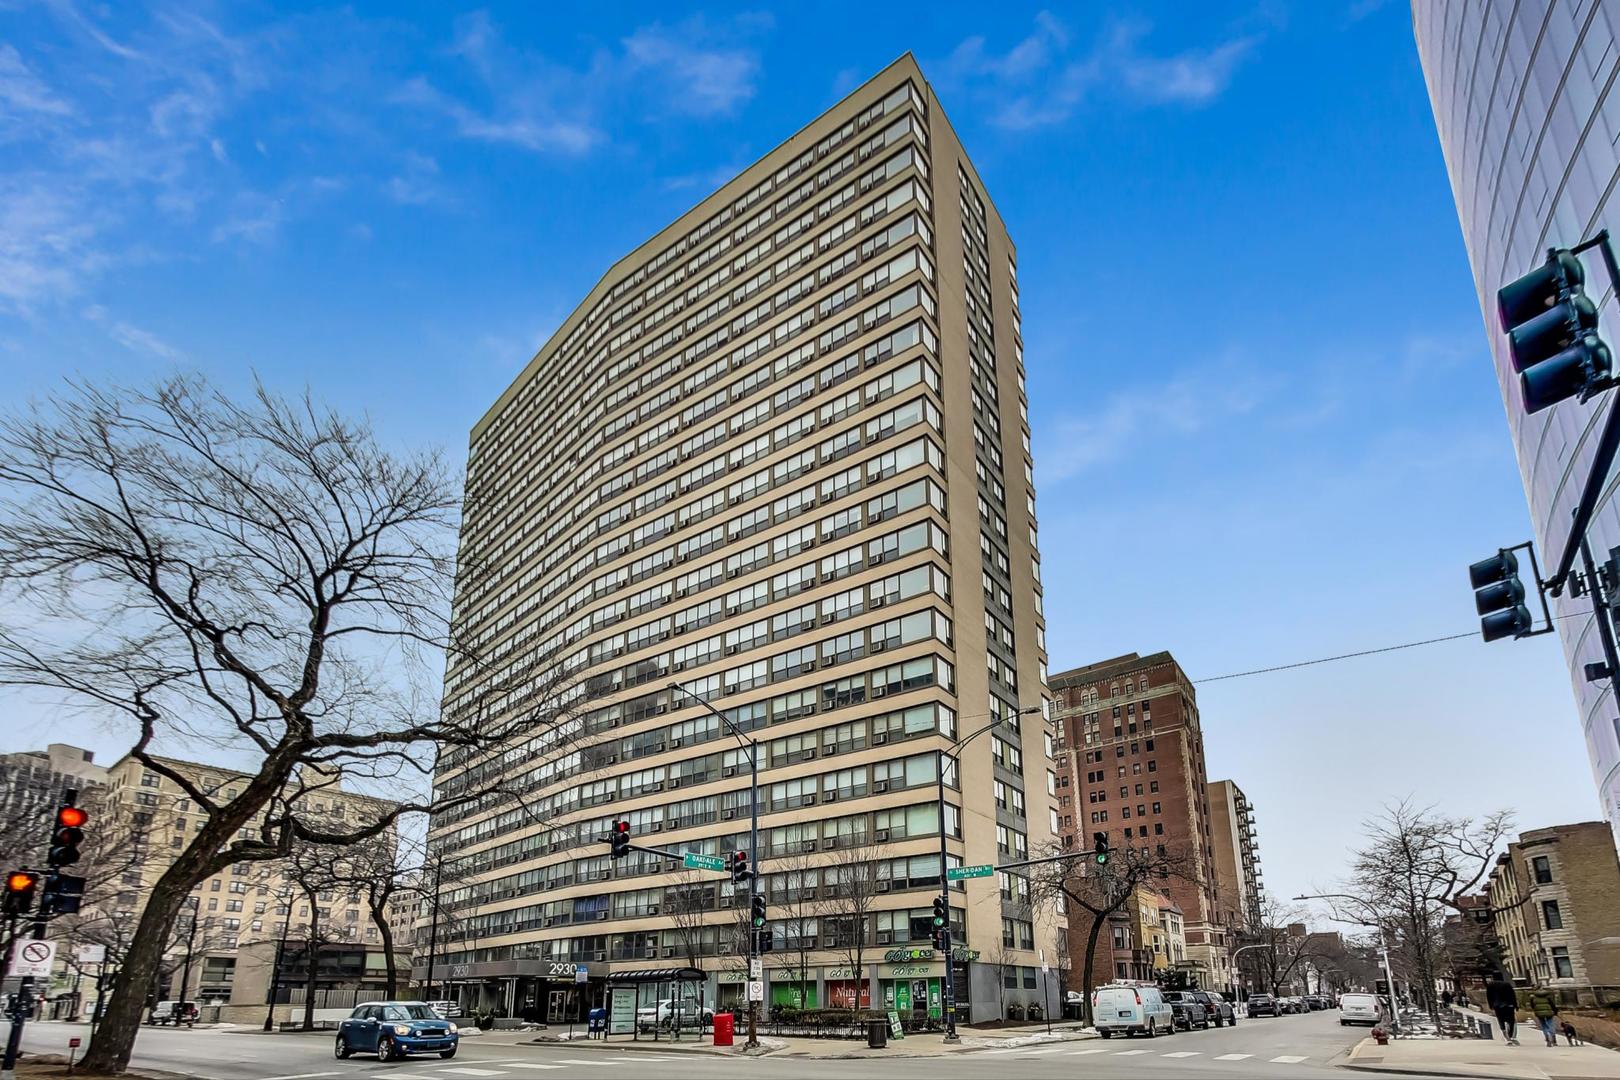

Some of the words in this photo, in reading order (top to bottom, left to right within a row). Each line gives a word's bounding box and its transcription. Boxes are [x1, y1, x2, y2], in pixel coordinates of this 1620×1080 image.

[452, 965, 469, 977] 2930
[549, 963, 577, 975] 2930
[835, 986, 870, 998] Natual
